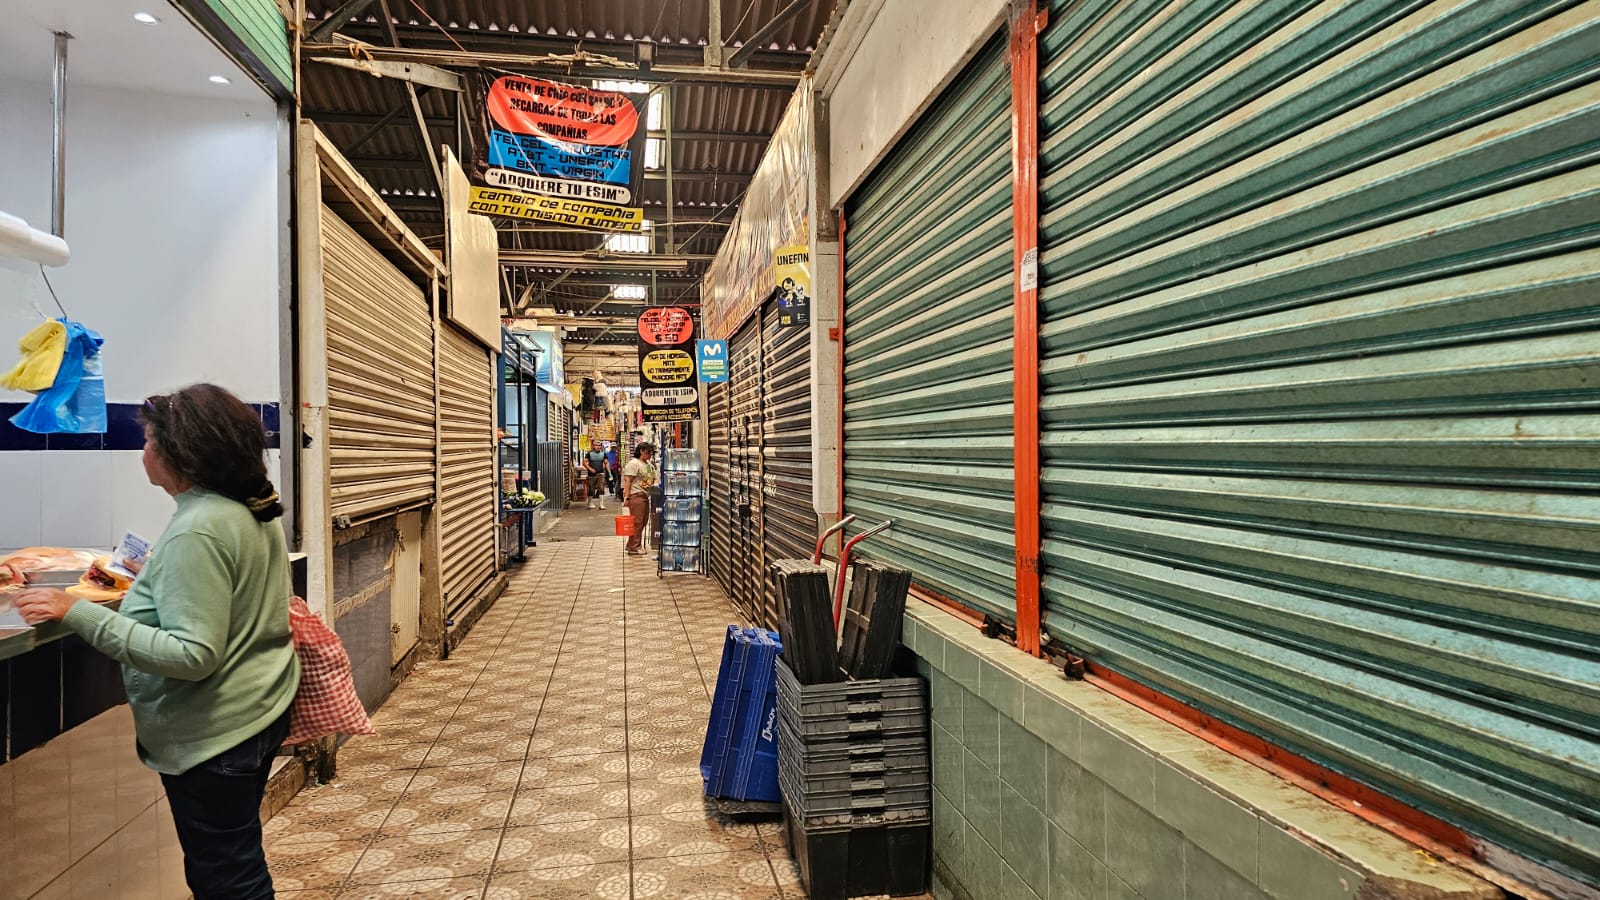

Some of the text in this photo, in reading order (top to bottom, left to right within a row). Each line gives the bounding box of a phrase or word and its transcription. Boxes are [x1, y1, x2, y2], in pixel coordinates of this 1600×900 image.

[505, 79, 531, 93] VENTA
[535, 85, 545, 97] DE
[547, 86, 568, 100] CHIP
[570, 92, 587, 103] CON
[510, 98, 555, 116] RECARGAS
[557, 107, 568, 120] DE
[600, 113, 616, 126] LAS
[537, 121, 587, 140] COMPAÑIAS
[493, 133, 546, 149] TELCEL
[508, 148, 546, 160] AT&T
[560, 153, 614, 169] UNEFON
[516, 160, 546, 171] BAIT
[562, 166, 605, 179] VIRGIN
[567, 183, 582, 195] TU
[777, 253, 809, 265] UNEFON
